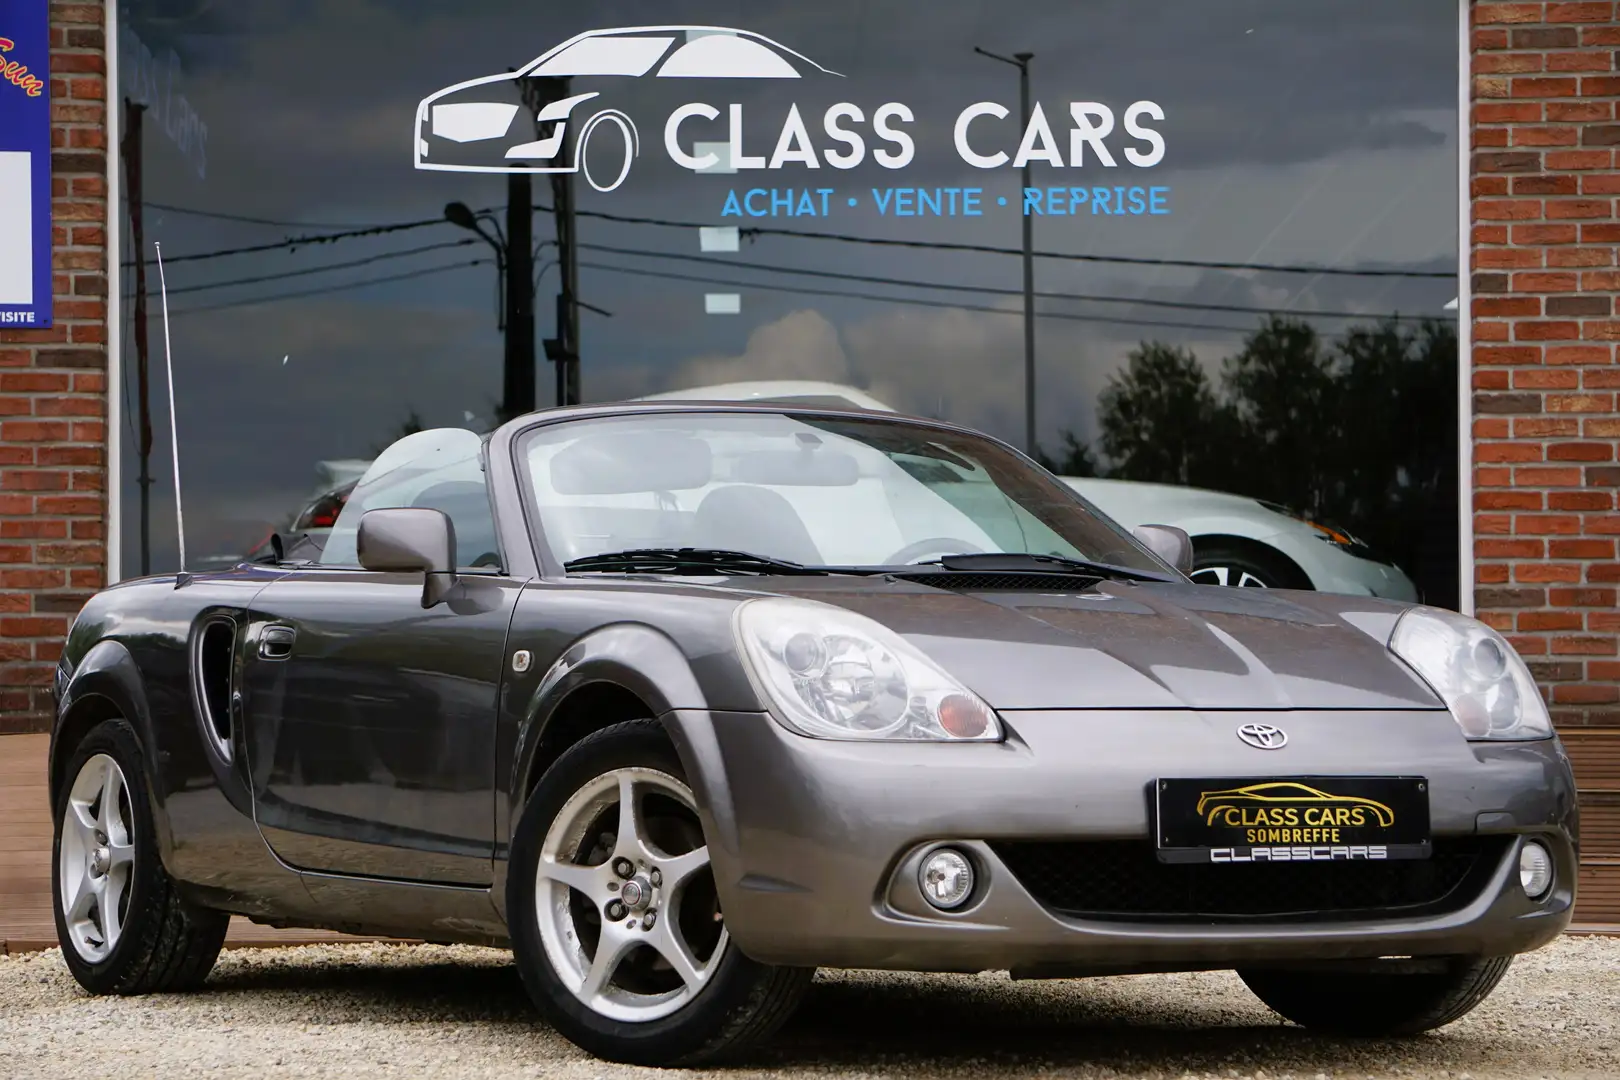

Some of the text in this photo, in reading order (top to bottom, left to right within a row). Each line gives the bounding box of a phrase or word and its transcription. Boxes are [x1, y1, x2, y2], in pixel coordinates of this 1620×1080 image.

[664, 100, 1166, 169] CLASS CARS
[721, 186, 1171, 217] ACHAT VENTE REPRISE
[0, 311, 35, 323] ISITE
[1224, 807, 1366, 826] CLASS CARS
[1246, 828, 1341, 843] SOMBREFFE
[1210, 845, 1388, 862] CLASSCARS
